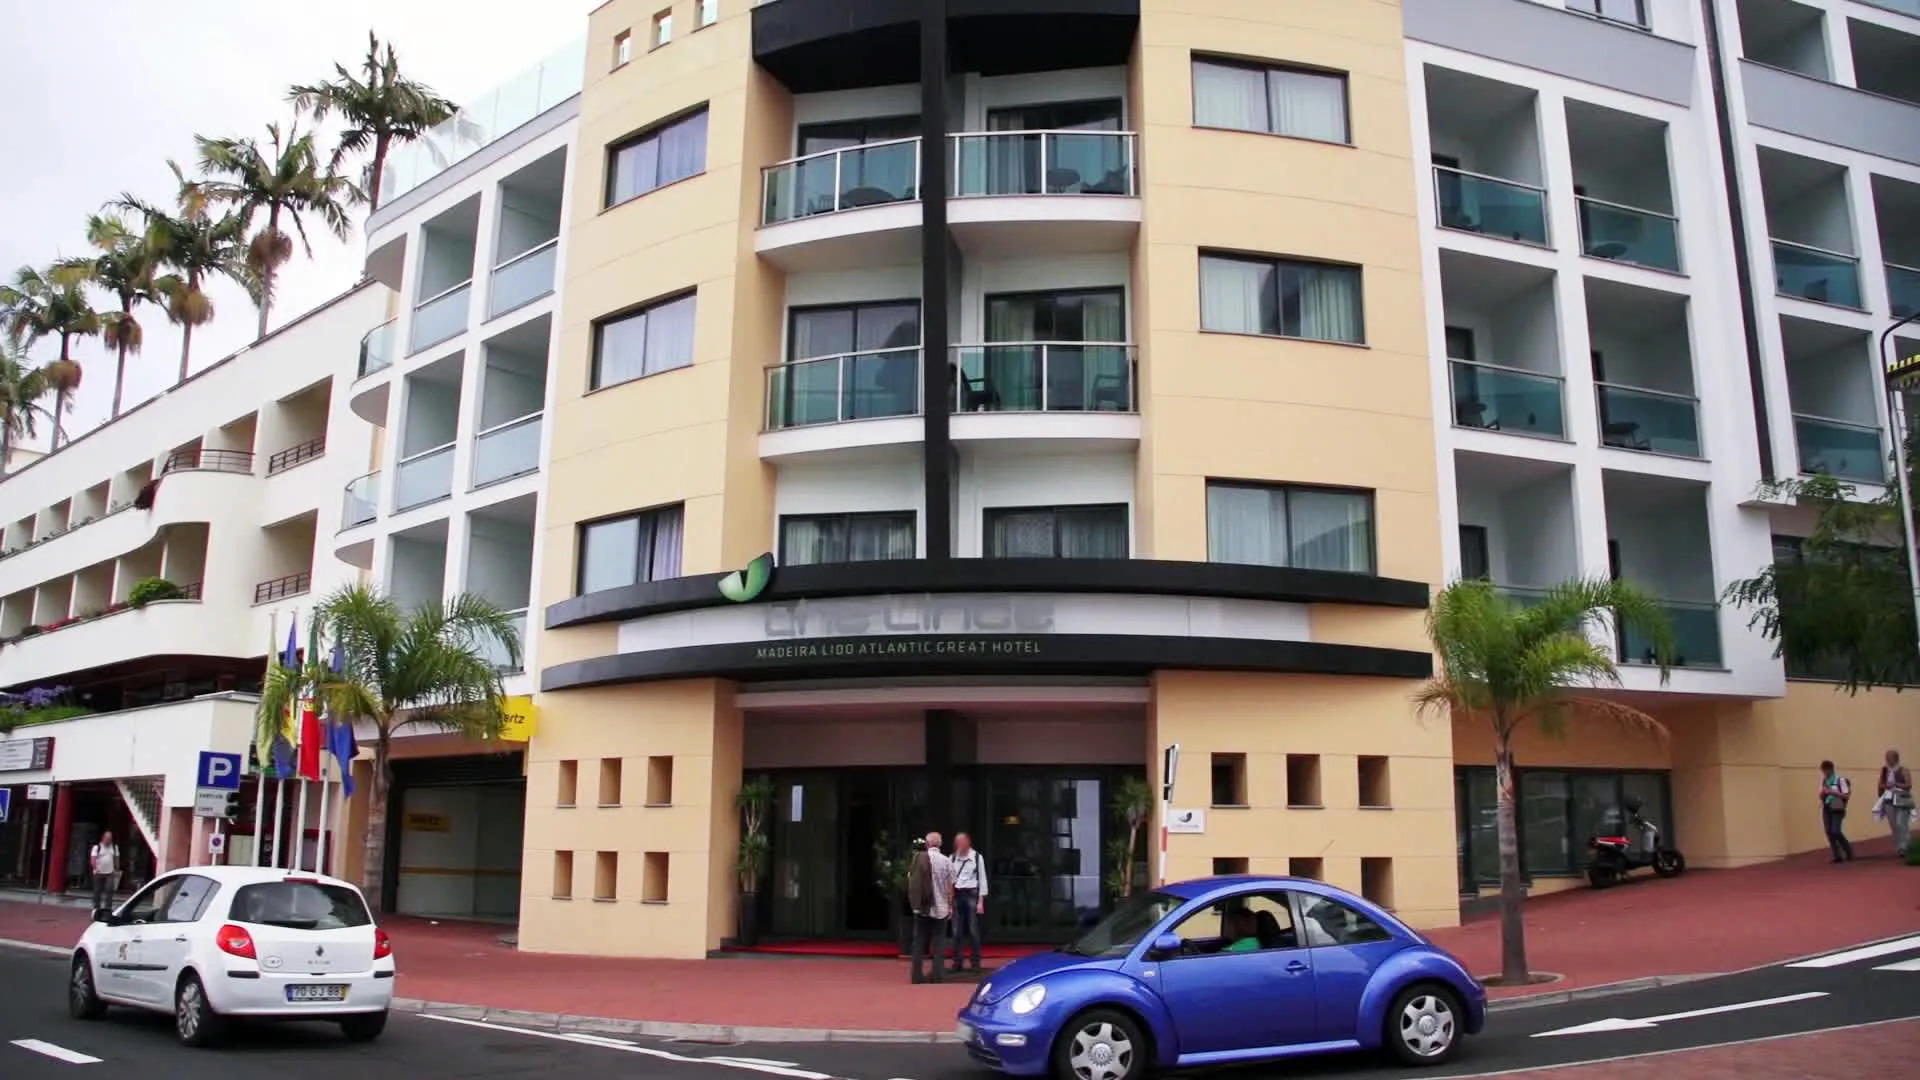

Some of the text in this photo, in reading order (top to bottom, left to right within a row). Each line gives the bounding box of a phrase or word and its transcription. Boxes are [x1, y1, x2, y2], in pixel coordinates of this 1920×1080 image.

[756, 645, 817, 658] MADEIRA
[859, 641, 931, 655] ATLANTIC
[936, 640, 986, 654] GREAT
[992, 640, 1040, 654] HOTEL
[208, 757, 232, 785] P
